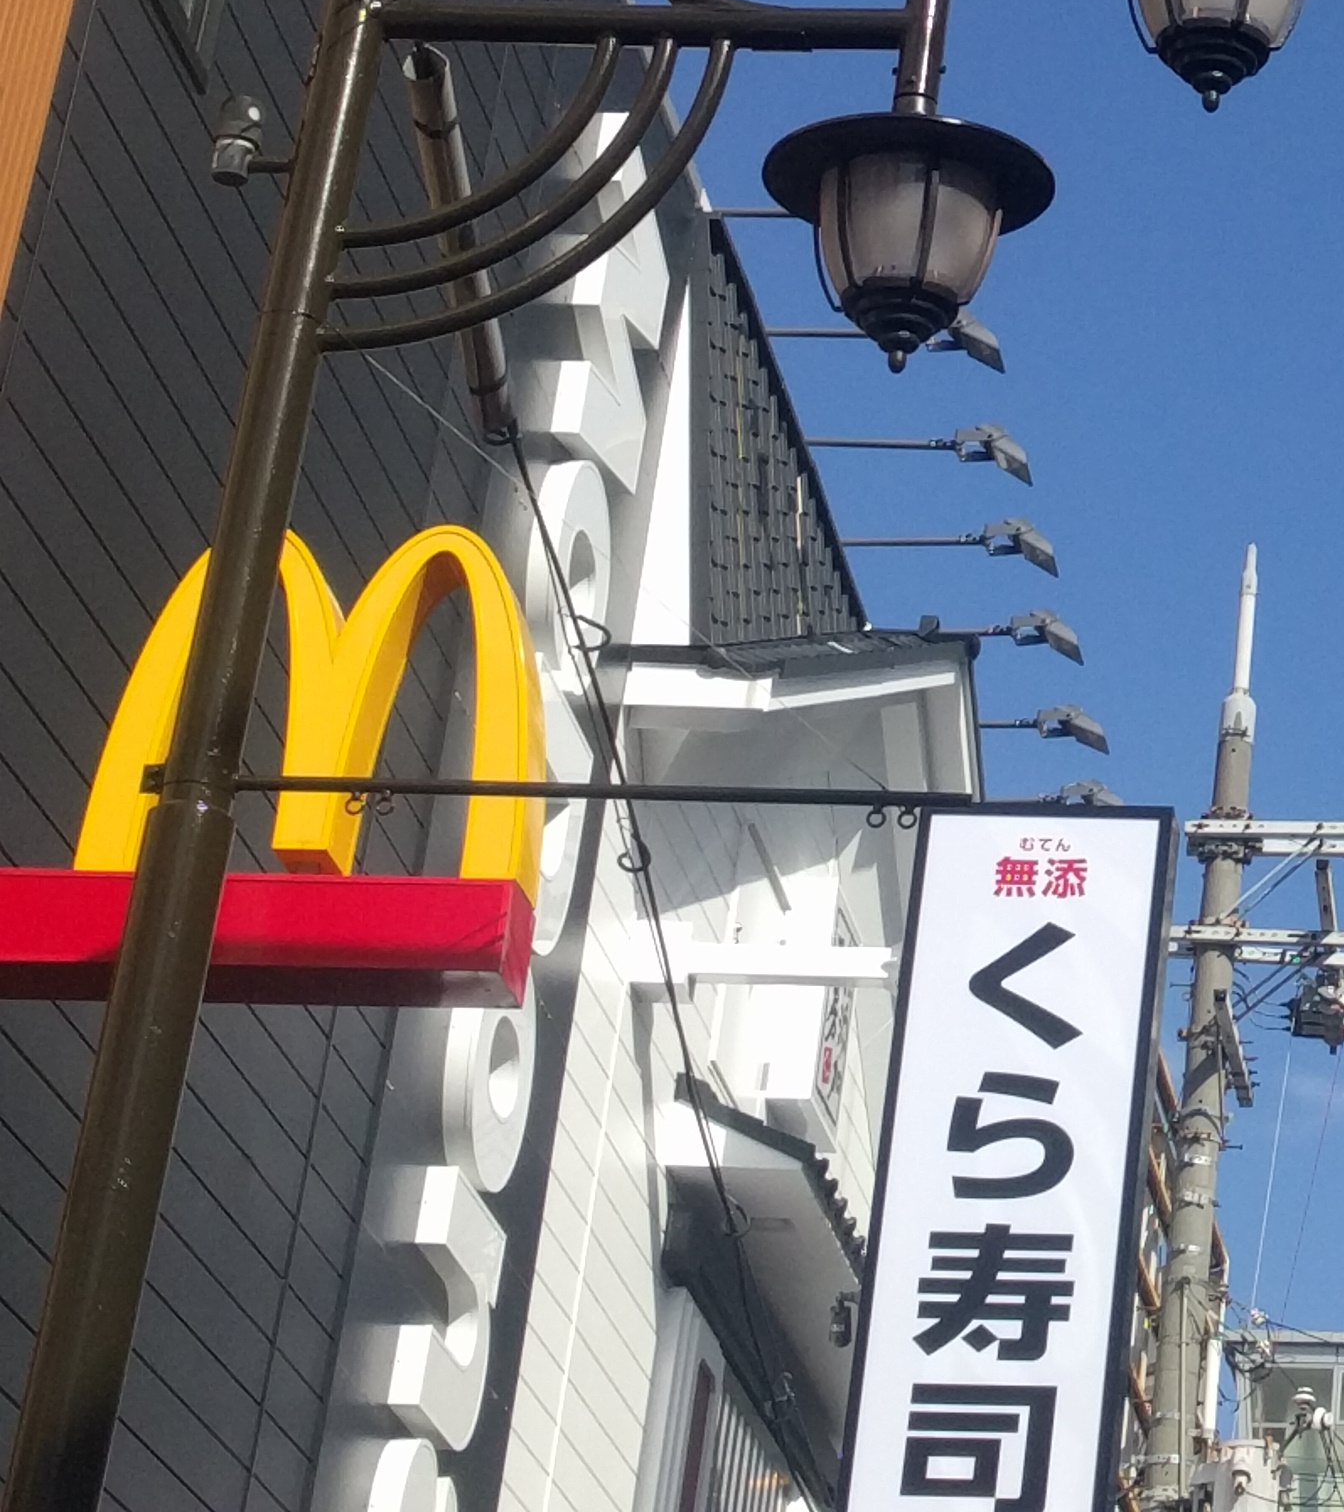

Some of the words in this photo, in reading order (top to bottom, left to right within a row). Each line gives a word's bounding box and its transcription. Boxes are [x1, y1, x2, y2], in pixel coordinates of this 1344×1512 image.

[1019, 837, 1071, 852] むてん
[993, 856, 1088, 899] 無添
[899, 921, 1084, 1512] くら寿司
